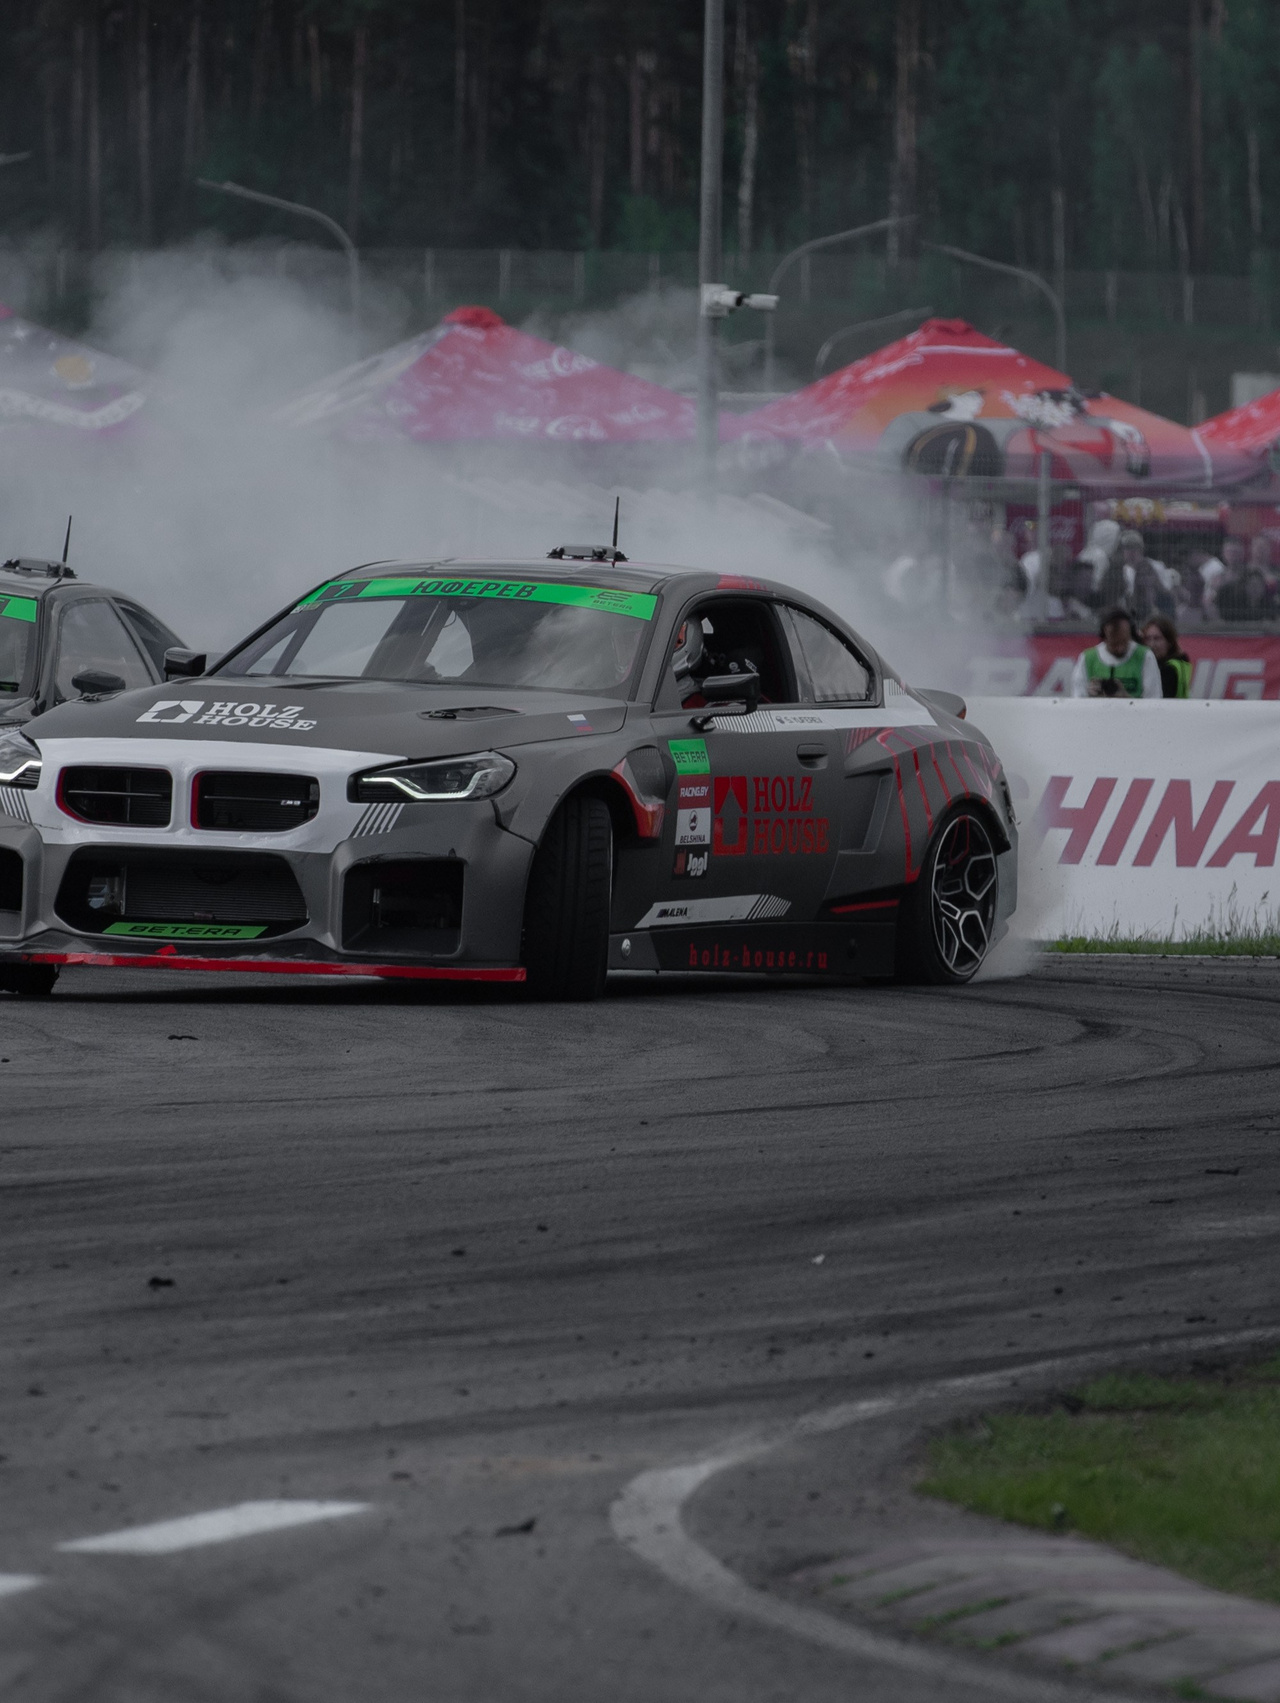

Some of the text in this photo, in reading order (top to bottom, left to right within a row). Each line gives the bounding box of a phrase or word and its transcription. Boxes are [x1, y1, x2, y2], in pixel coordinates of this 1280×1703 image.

[334, 584, 355, 598] 7
[410, 581, 537, 598] ЮФЕРЕВ
[204, 701, 304, 719] HOLZ
[193, 715, 317, 731] HOUSE
[752, 776, 815, 812] HOLZ
[1012, 773, 1280, 868] HINA
[679, 835, 706, 844] BELSHINA
[752, 818, 830, 855] HOUSE
[689, 943, 828, 969] holz-house.ru
